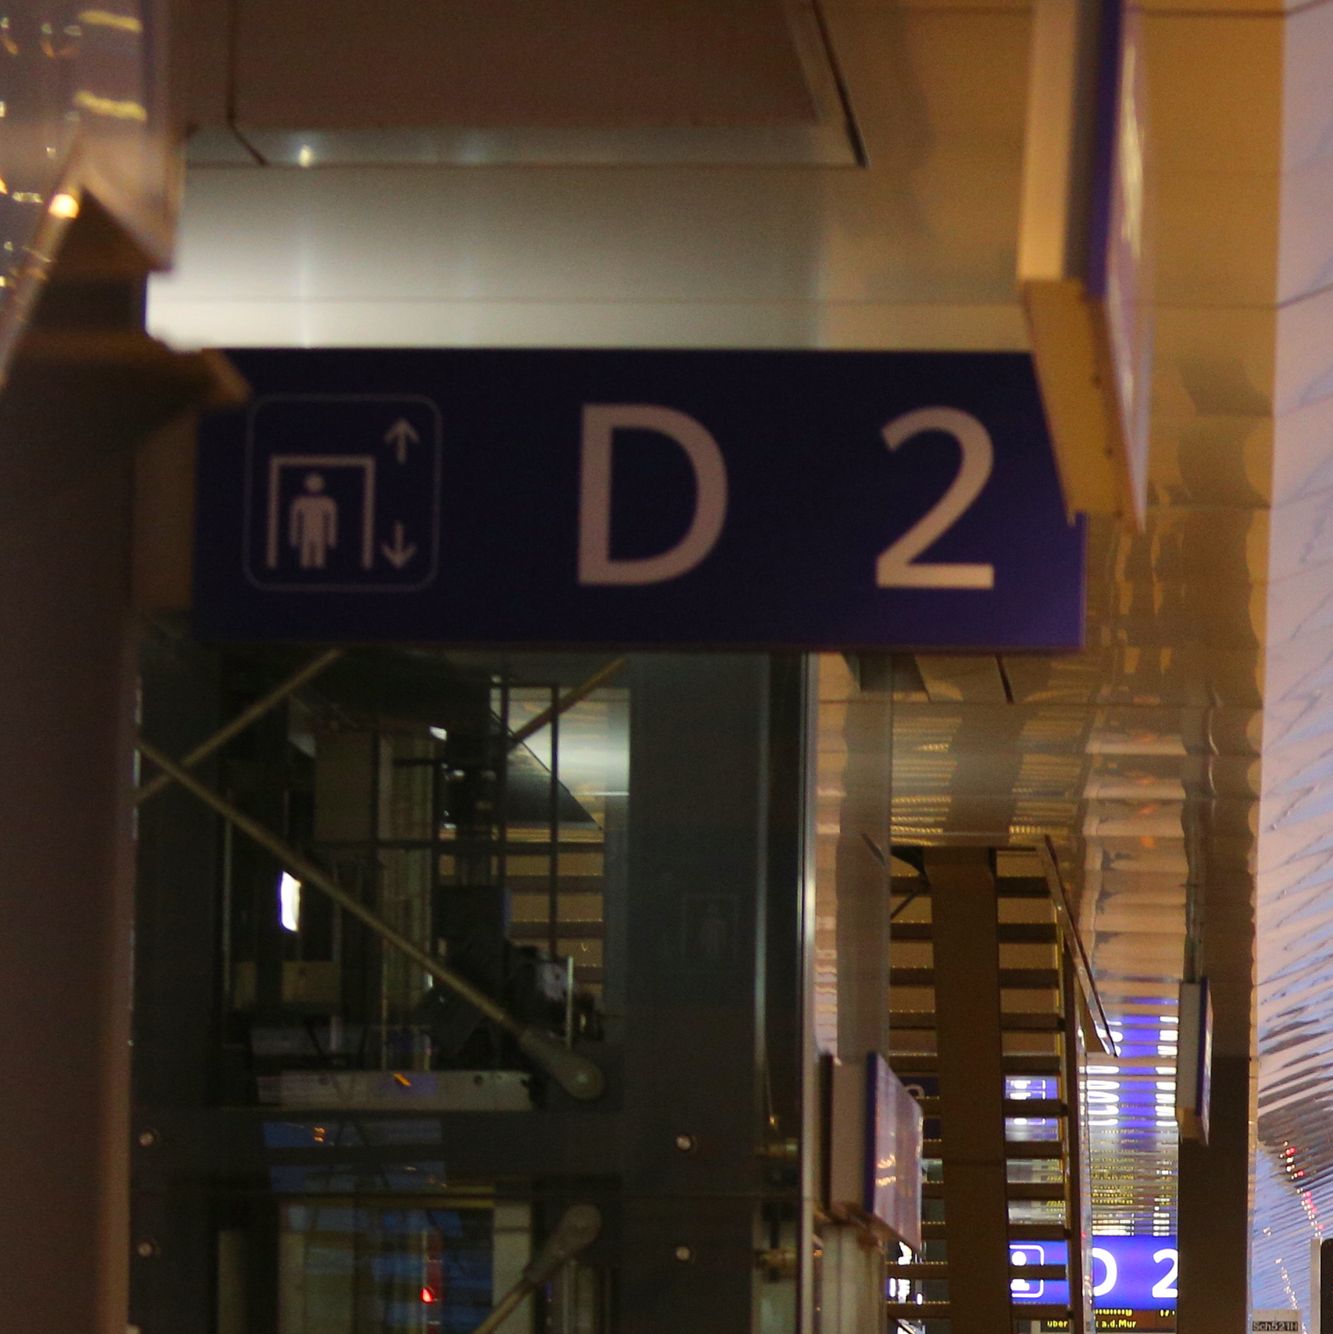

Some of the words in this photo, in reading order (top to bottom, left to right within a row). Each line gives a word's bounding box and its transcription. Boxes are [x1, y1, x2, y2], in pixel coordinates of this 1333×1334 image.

[578, 403, 728, 585] D
[876, 405, 994, 589] 2
[1152, 1248, 1178, 1298] 2
